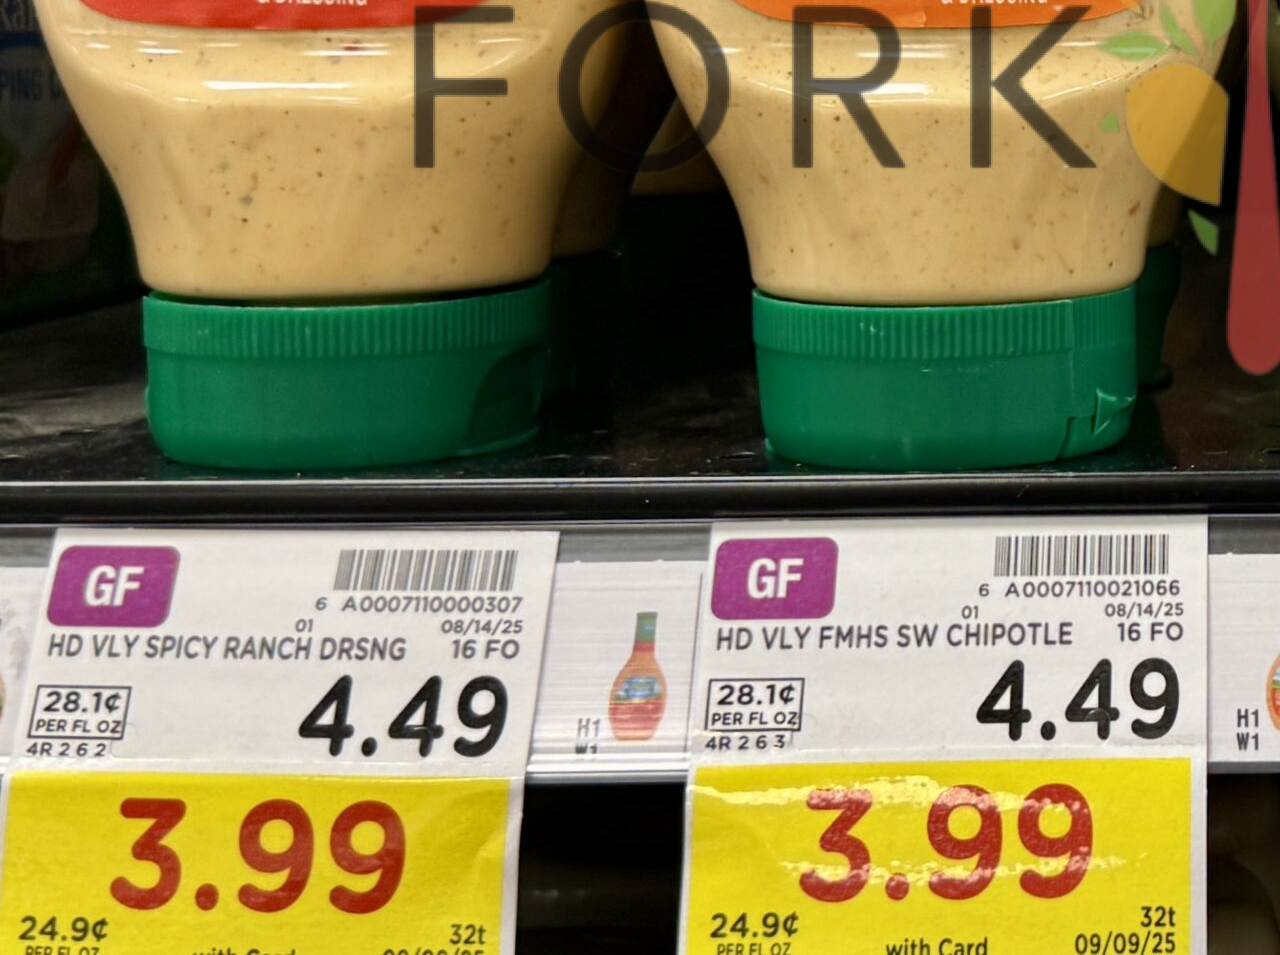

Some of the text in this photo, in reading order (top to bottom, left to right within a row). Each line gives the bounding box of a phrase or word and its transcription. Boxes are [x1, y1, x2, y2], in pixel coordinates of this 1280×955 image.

[84, 565, 144, 607] GF
[747, 558, 803, 600] GF
[1005, 580, 1181, 599] A0007110021066
[341, 596, 523, 614] A0007110000307
[1105, 602, 1184, 618] 08/14/25
[441, 619, 523, 635] 08/14/25
[716, 622, 1184, 651] HD VLY FMHS SW CHIPOTLE 16 FO
[47, 634, 520, 662] HD VLY SPICY RANCH DRSNG 16 FO
[43, 691, 121, 715] 28.1¢
[717, 684, 796, 707] 28.1¢
[976, 658, 1180, 741] 4.49
[299, 675, 508, 758] 4.49
[1237, 709, 1260, 729] H1
[1236, 732, 1260, 751] W1
[799, 783, 1094, 902] 3.99
[110, 798, 406, 914] 3.99
[710, 914, 799, 939] 24.9¢
[1141, 906, 1176, 928] 32t
[19, 917, 108, 943] 24.9¢
